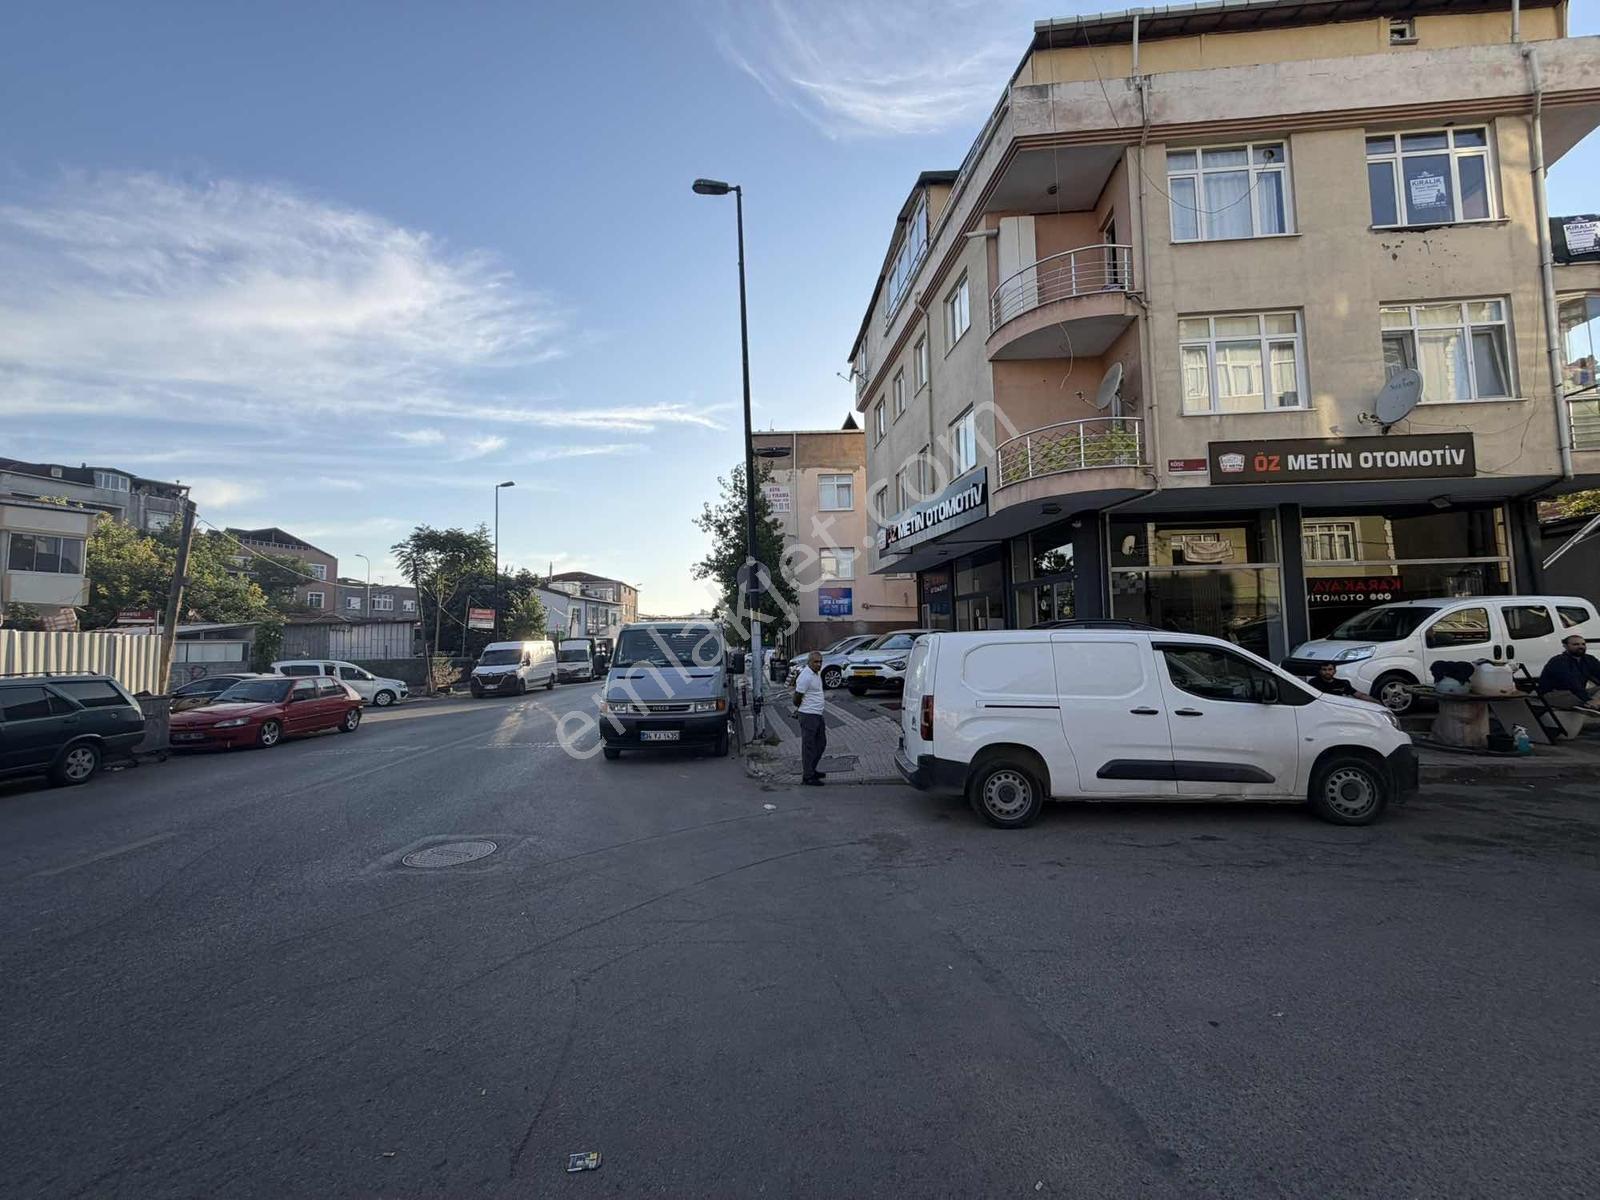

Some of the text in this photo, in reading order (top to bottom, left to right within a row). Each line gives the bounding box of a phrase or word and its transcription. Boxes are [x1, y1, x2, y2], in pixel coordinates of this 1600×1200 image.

[1253, 445, 1466, 472] ÖZ METİN OTOMOTİV
[898, 511, 925, 539] METİN
[926, 483, 983, 526] OTOMOTİV
